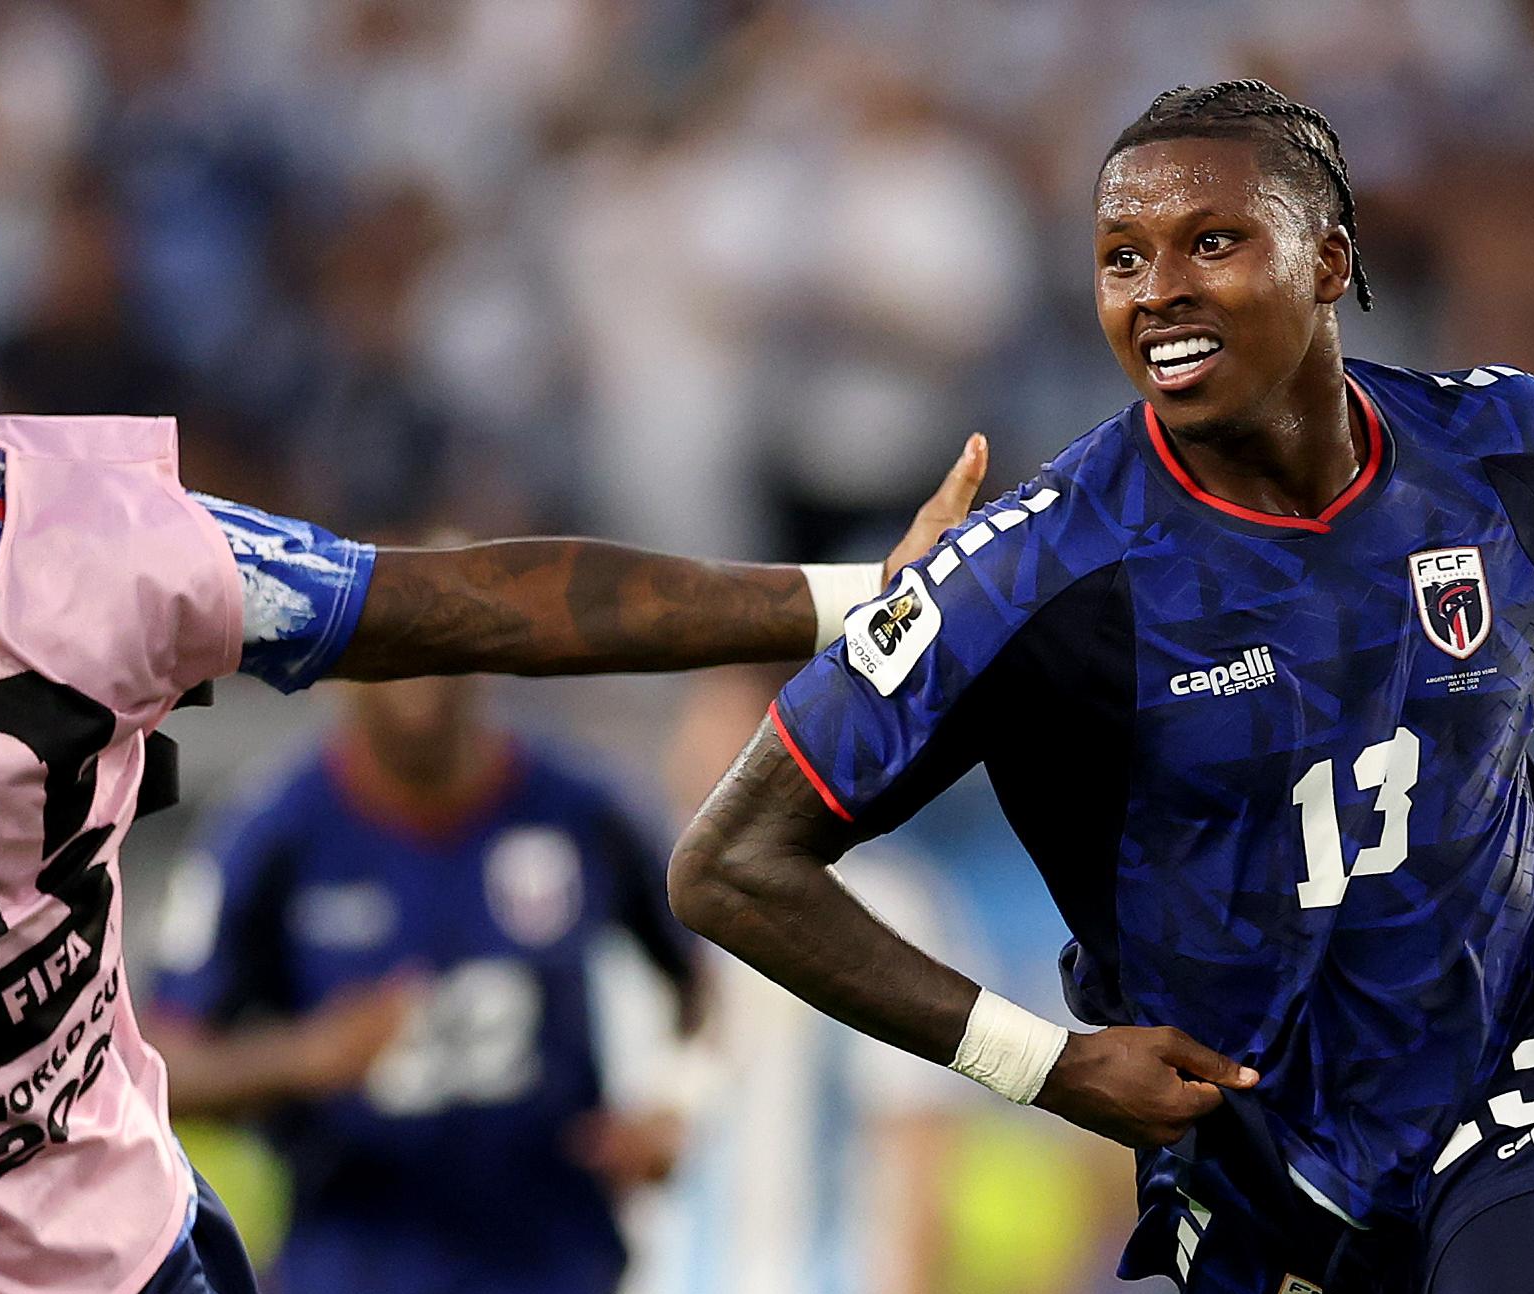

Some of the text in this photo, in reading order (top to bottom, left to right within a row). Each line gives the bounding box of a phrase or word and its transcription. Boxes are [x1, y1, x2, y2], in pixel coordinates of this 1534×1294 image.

[1417, 553, 1474, 577] FCF
[848, 638, 878, 675] 2026
[1169, 645, 1276, 697] capelli
[1425, 673, 1458, 684] ARGENTINA
[1223, 671, 1277, 697] SPORT
[1292, 726, 1420, 910] 13
[0, 929, 93, 1025] FIFA
[90, 966, 119, 1024] CU
